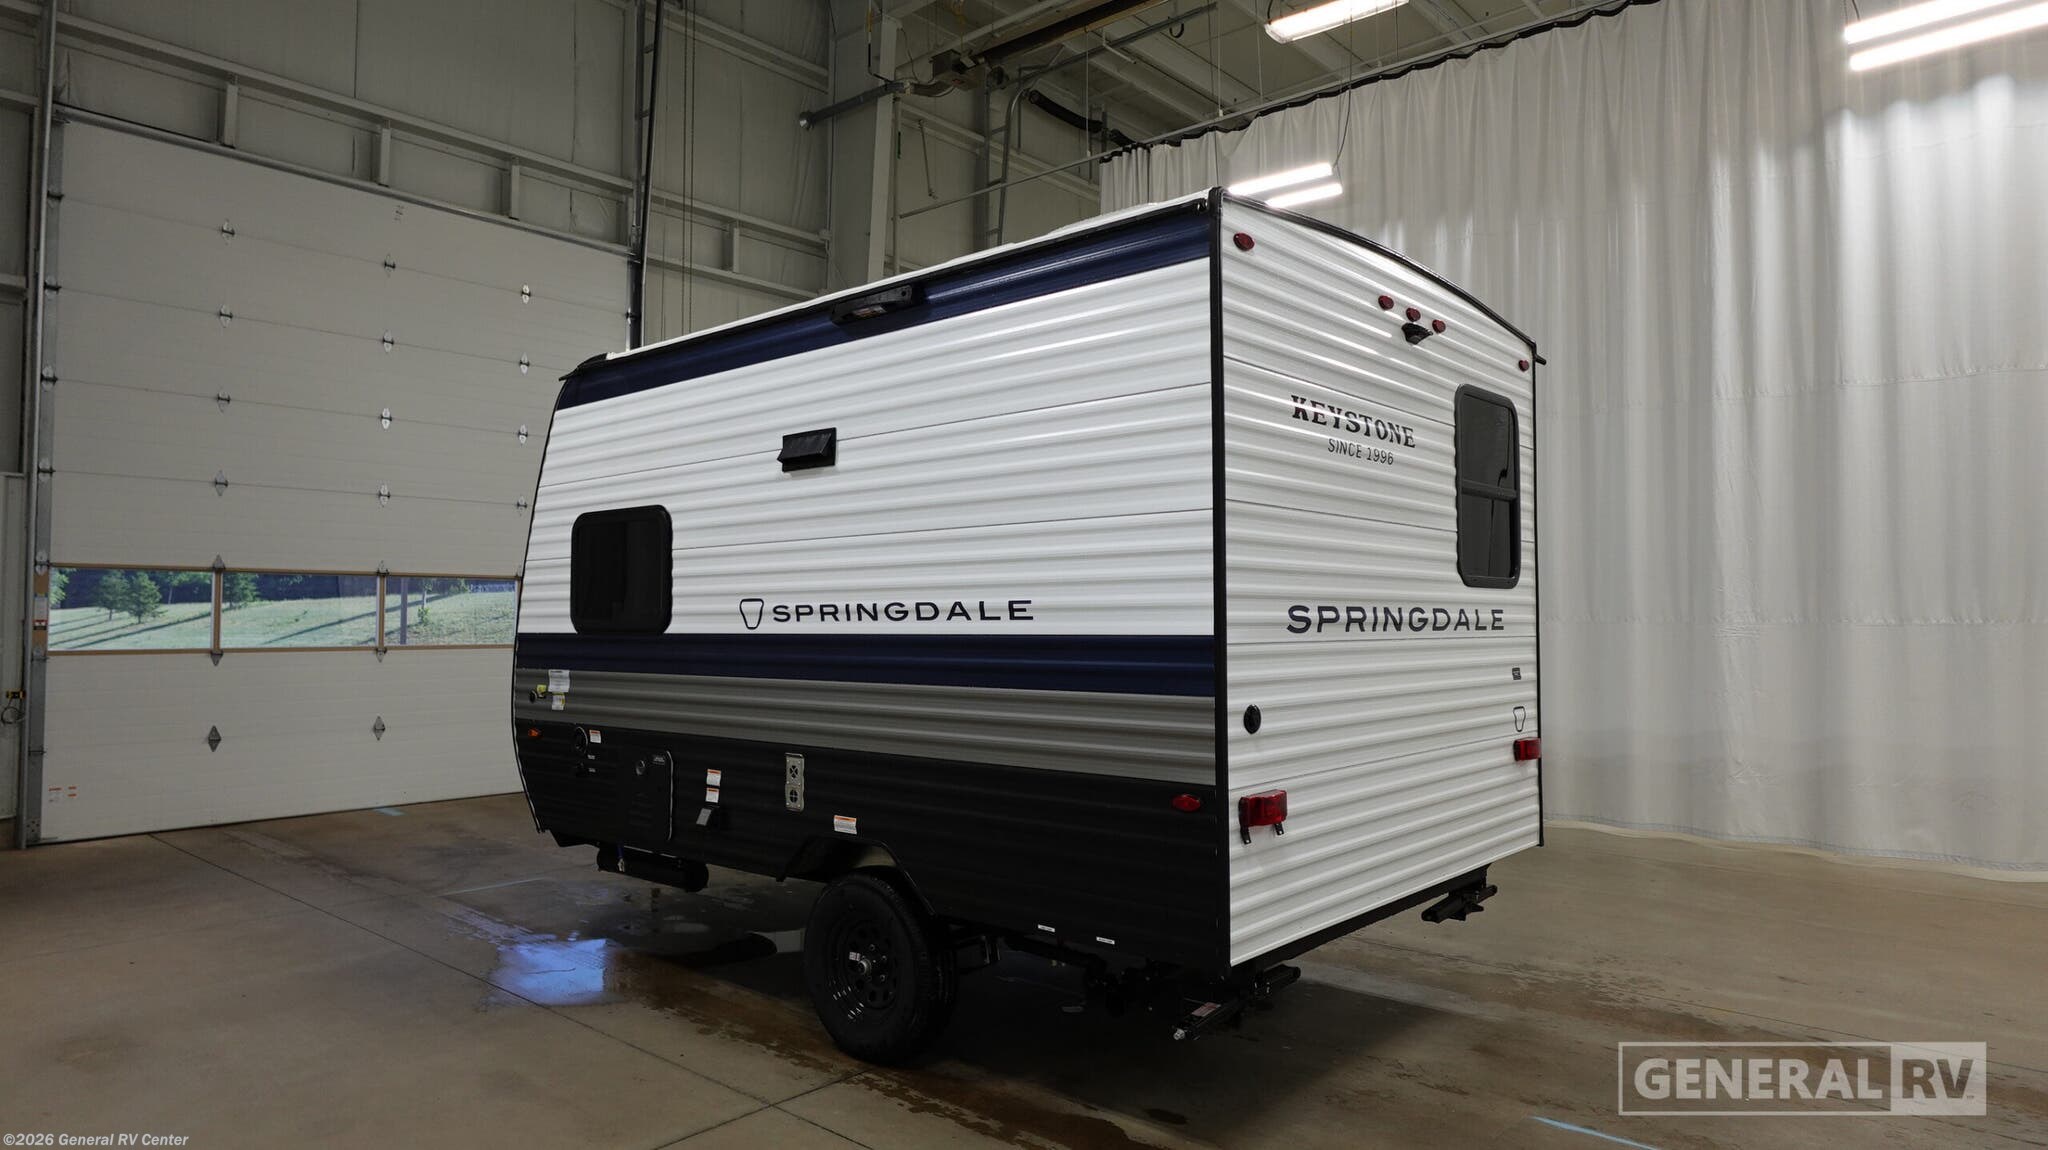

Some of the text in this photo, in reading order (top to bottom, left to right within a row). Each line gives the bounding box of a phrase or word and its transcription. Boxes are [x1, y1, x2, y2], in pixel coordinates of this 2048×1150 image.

[1290, 394, 1416, 449] KEYSTONE
[1328, 437, 1394, 466] SINCE 1996
[772, 599, 1034, 623] SPRINGDALE
[1286, 604, 1505, 634] SPRINGDALE
